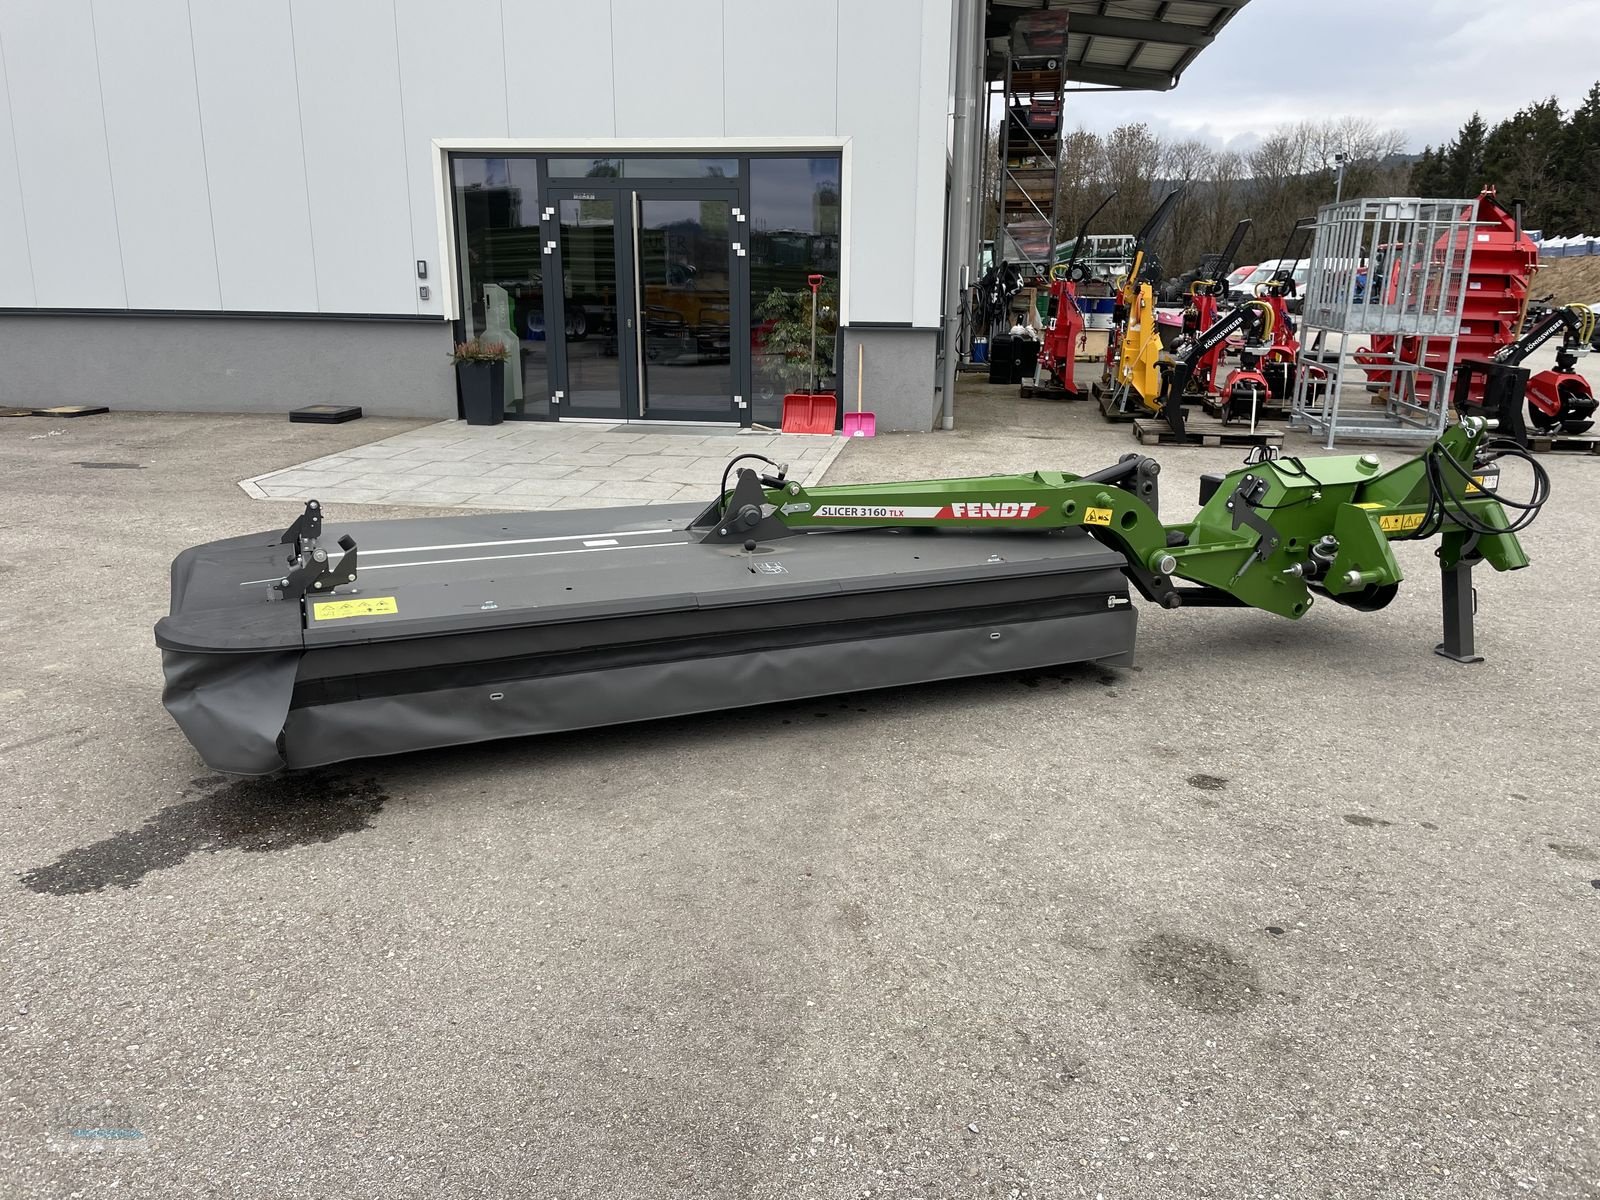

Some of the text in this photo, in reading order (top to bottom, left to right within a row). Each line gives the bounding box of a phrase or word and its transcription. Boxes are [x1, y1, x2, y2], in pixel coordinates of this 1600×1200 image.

[1203, 317, 1244, 349] KÖNIGSWIESER
[1524, 319, 1564, 353] KÖNIGSWIESER
[821, 502, 1037, 518] SLICER 3160 TLX FENDT
